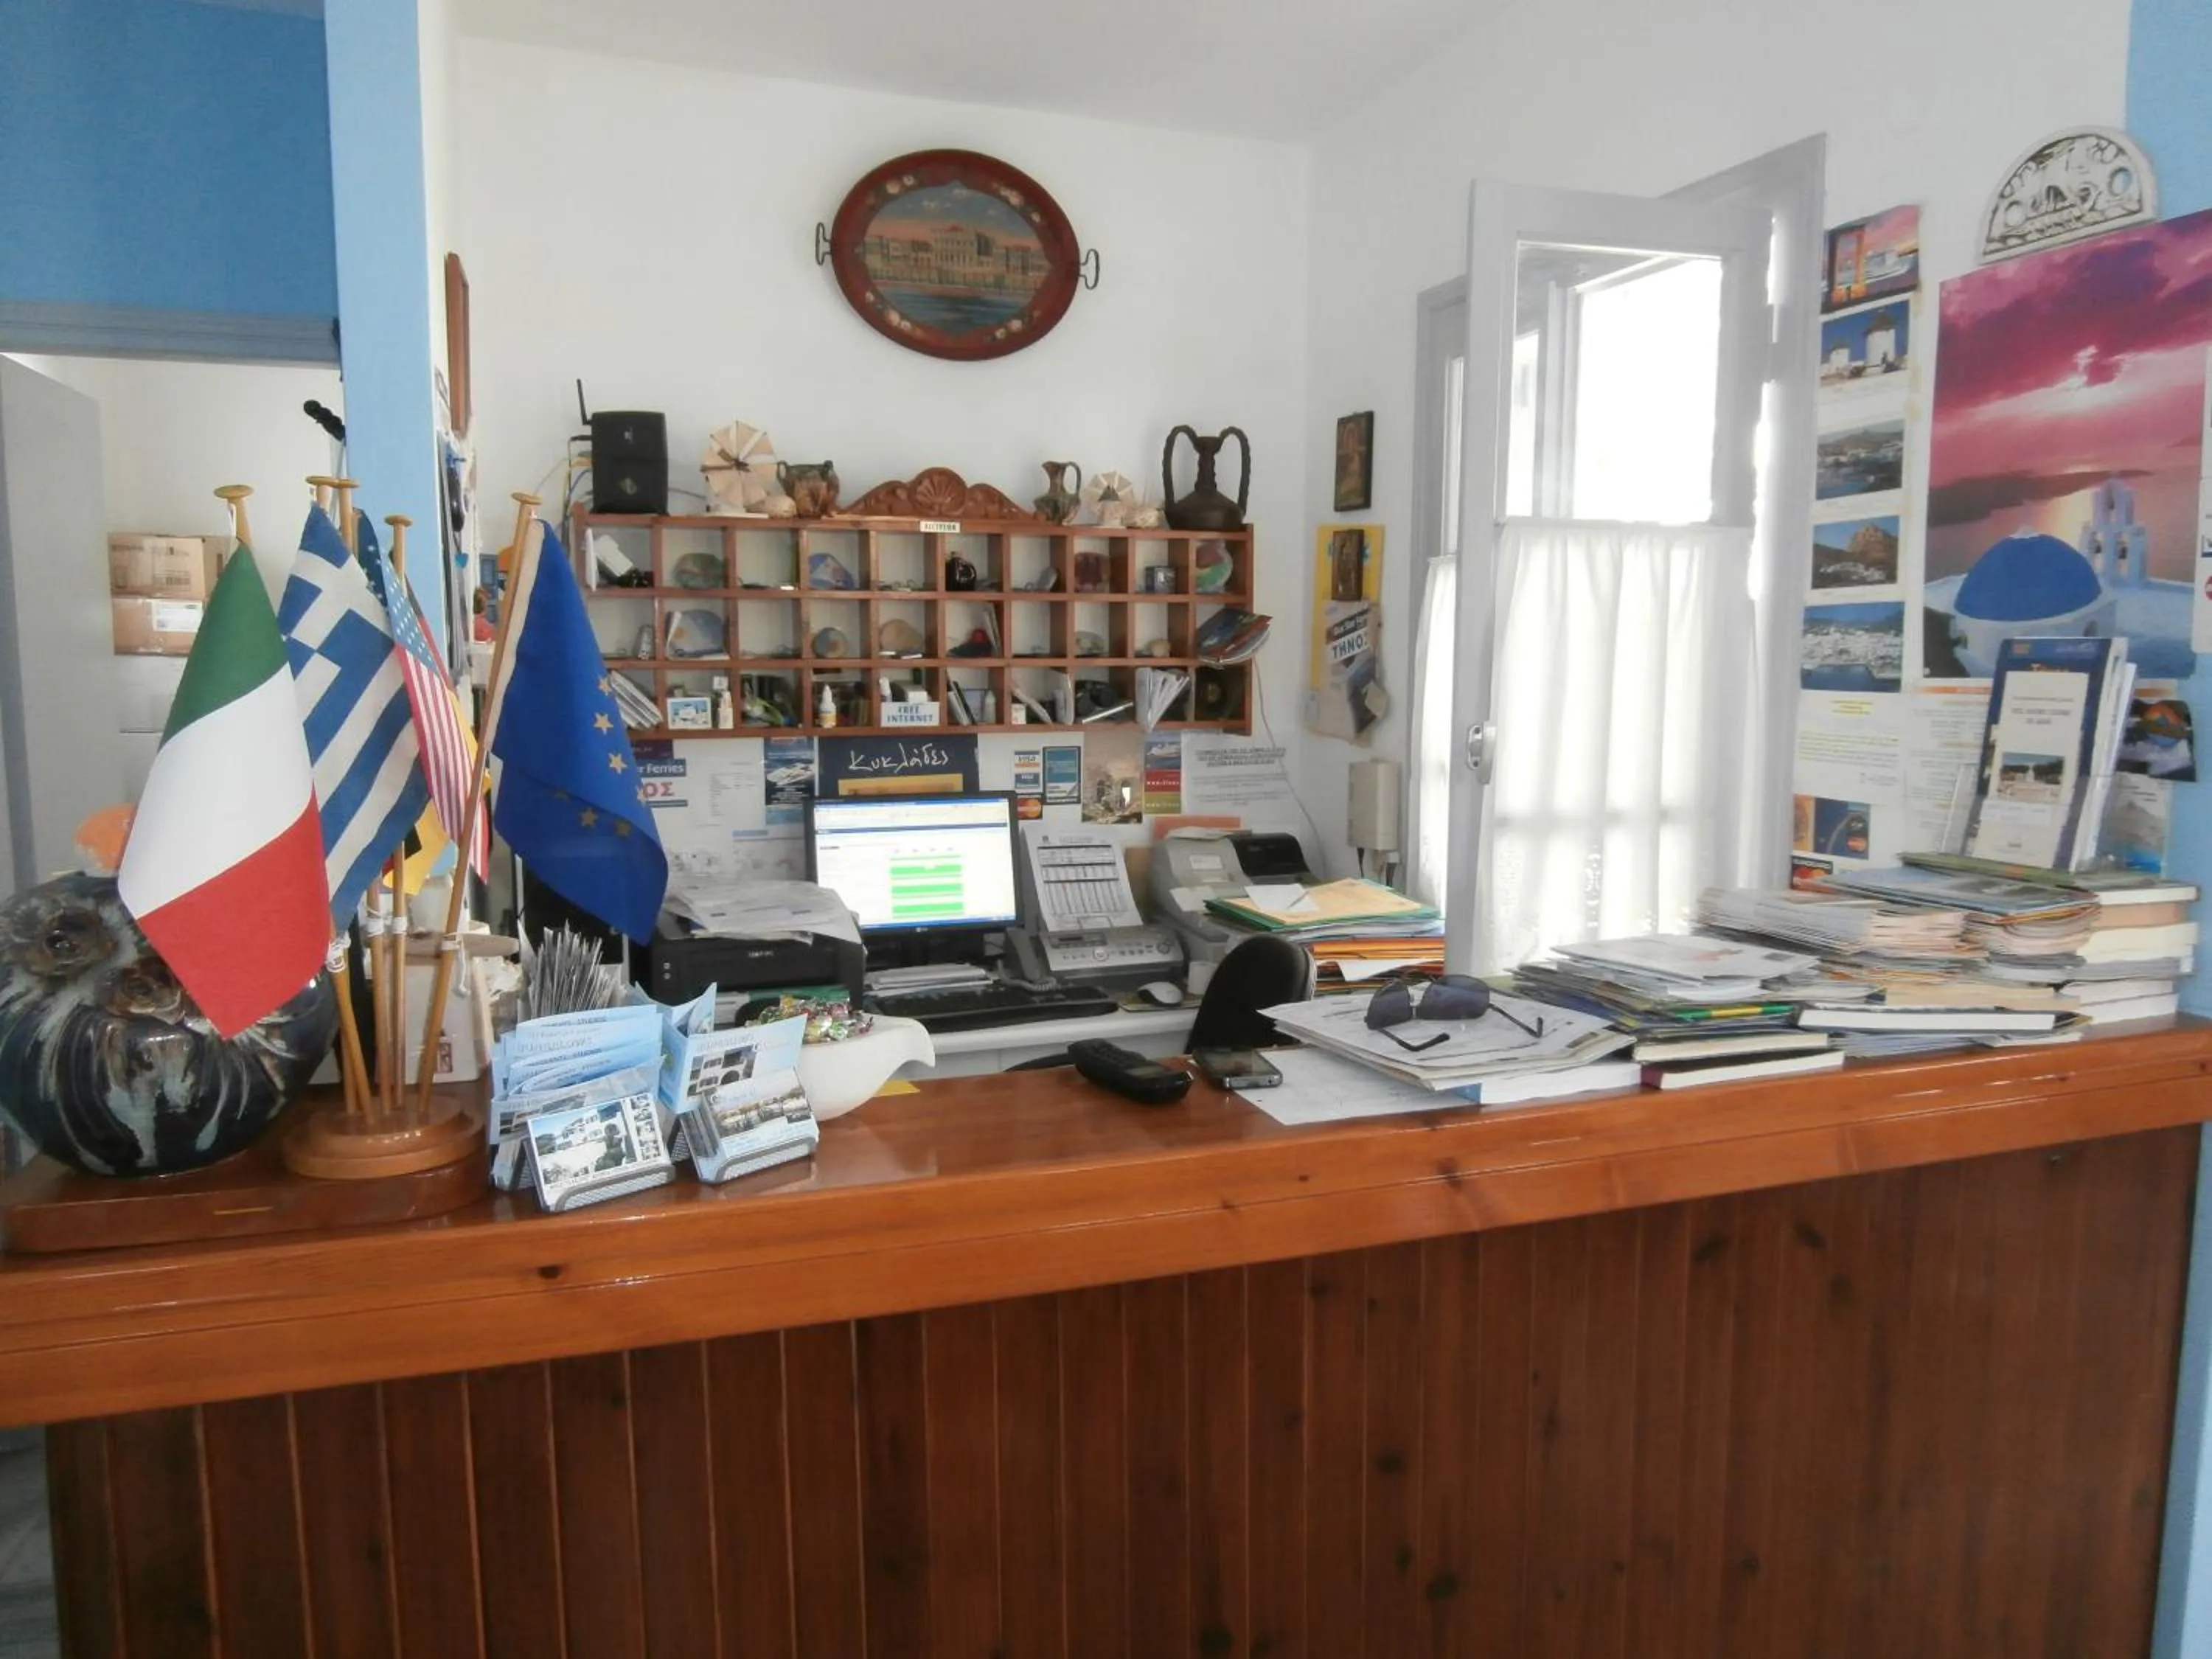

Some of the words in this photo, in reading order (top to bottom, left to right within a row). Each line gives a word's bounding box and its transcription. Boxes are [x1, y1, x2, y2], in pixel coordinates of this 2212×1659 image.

[897, 705, 920, 714] FREE
[887, 714, 933, 723] INTERNET
[647, 762, 684, 773] Ferries
[643, 782, 675, 798] ΟΣ
